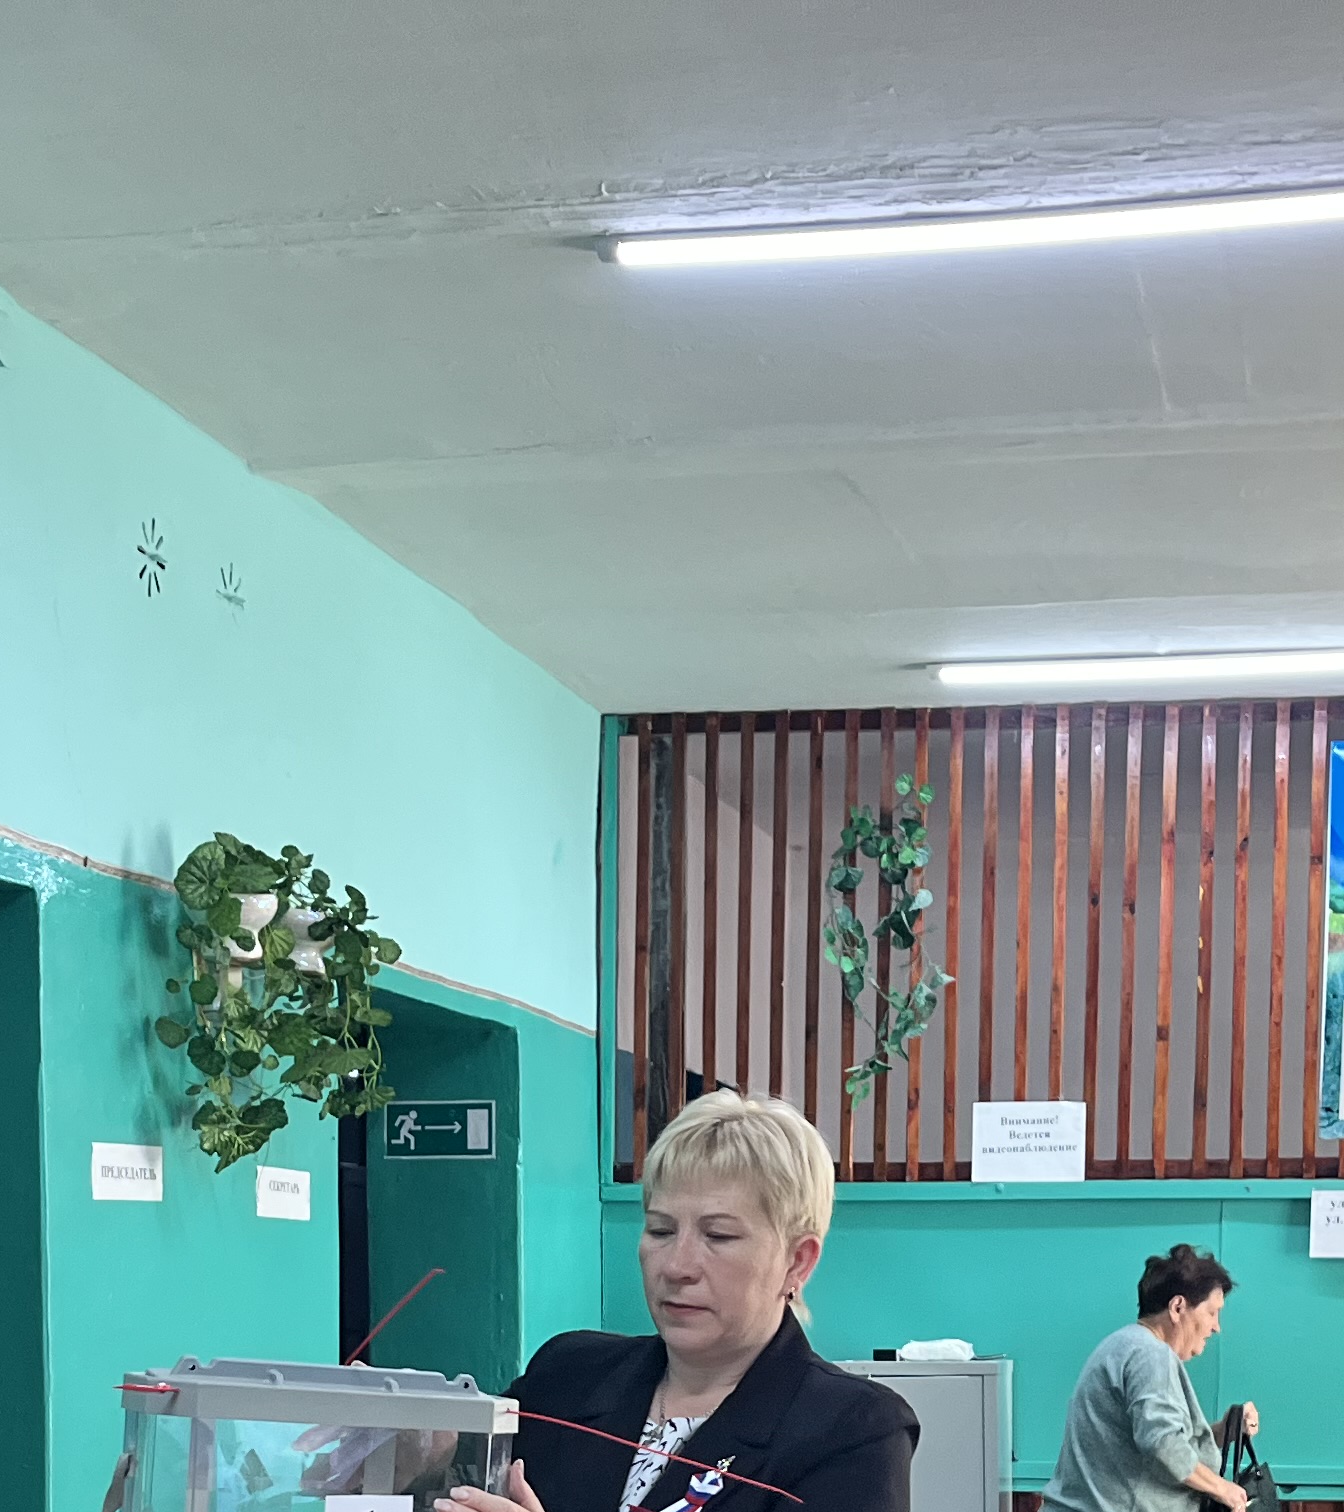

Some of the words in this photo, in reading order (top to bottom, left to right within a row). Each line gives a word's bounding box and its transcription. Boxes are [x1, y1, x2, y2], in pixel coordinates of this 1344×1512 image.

[1000, 1115, 1059, 1127] Внимание!
[1009, 1130, 1051, 1140] Ведется
[982, 1143, 1078, 1154] видеонаблюдение
[101, 1165, 157, 1180] ПРЕДСЕДАТЕЛЬ
[1325, 1215, 1343, 1227] ул.
